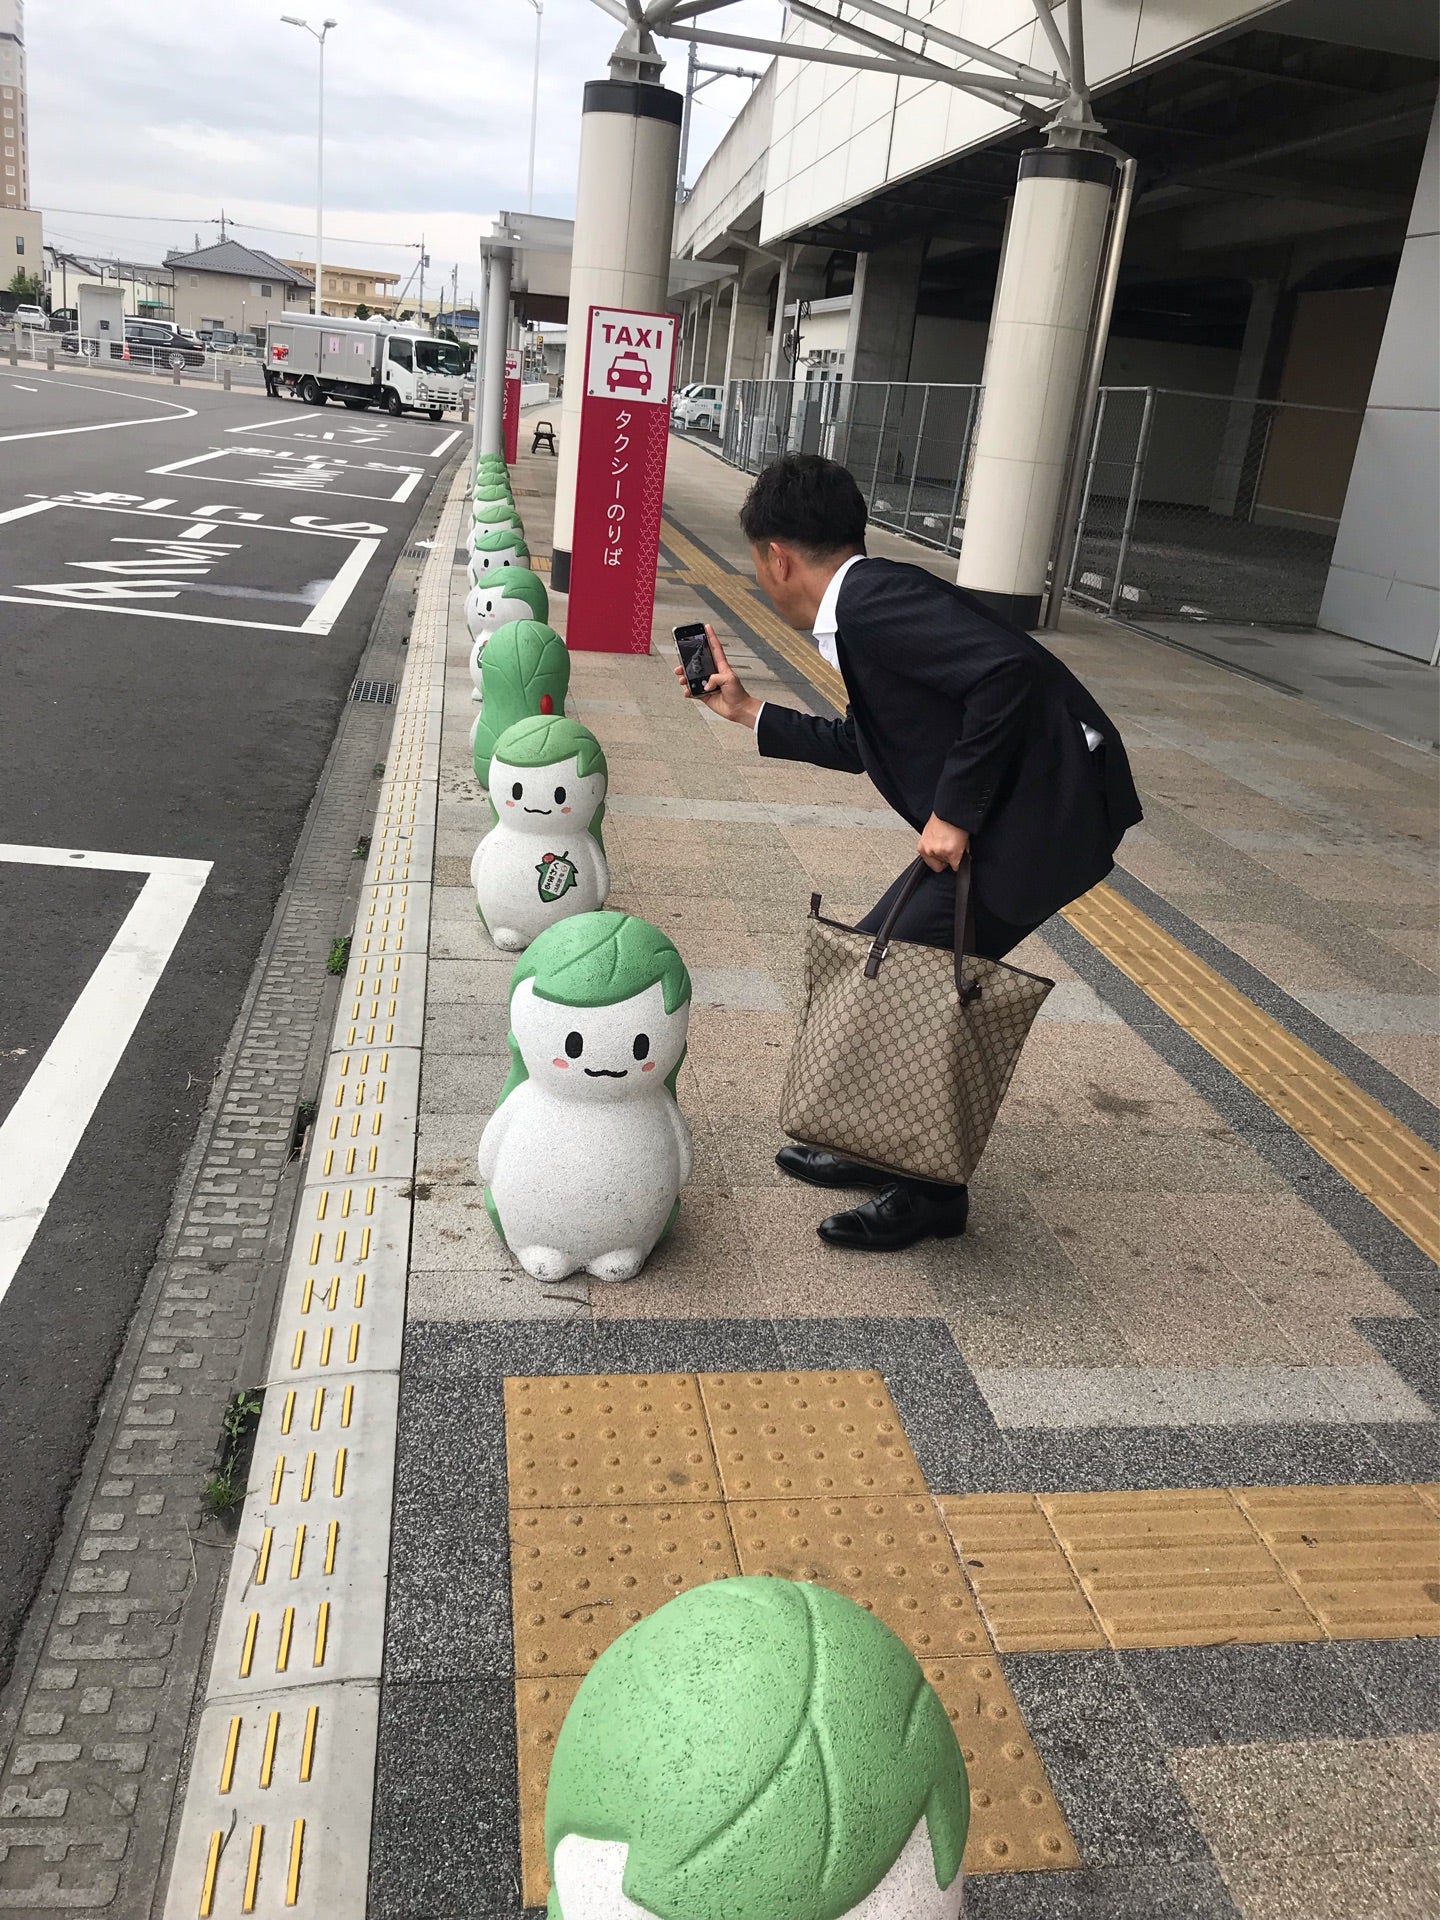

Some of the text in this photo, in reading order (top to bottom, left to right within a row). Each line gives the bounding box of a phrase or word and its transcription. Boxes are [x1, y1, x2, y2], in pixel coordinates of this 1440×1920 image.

[602, 324, 662, 349] TAXI
[244, 463, 345, 488] タクシー
[603, 410, 633, 566] タクシーのりば
[24, 491, 389, 535] のりば
[13, 523, 243, 599] タクシー
